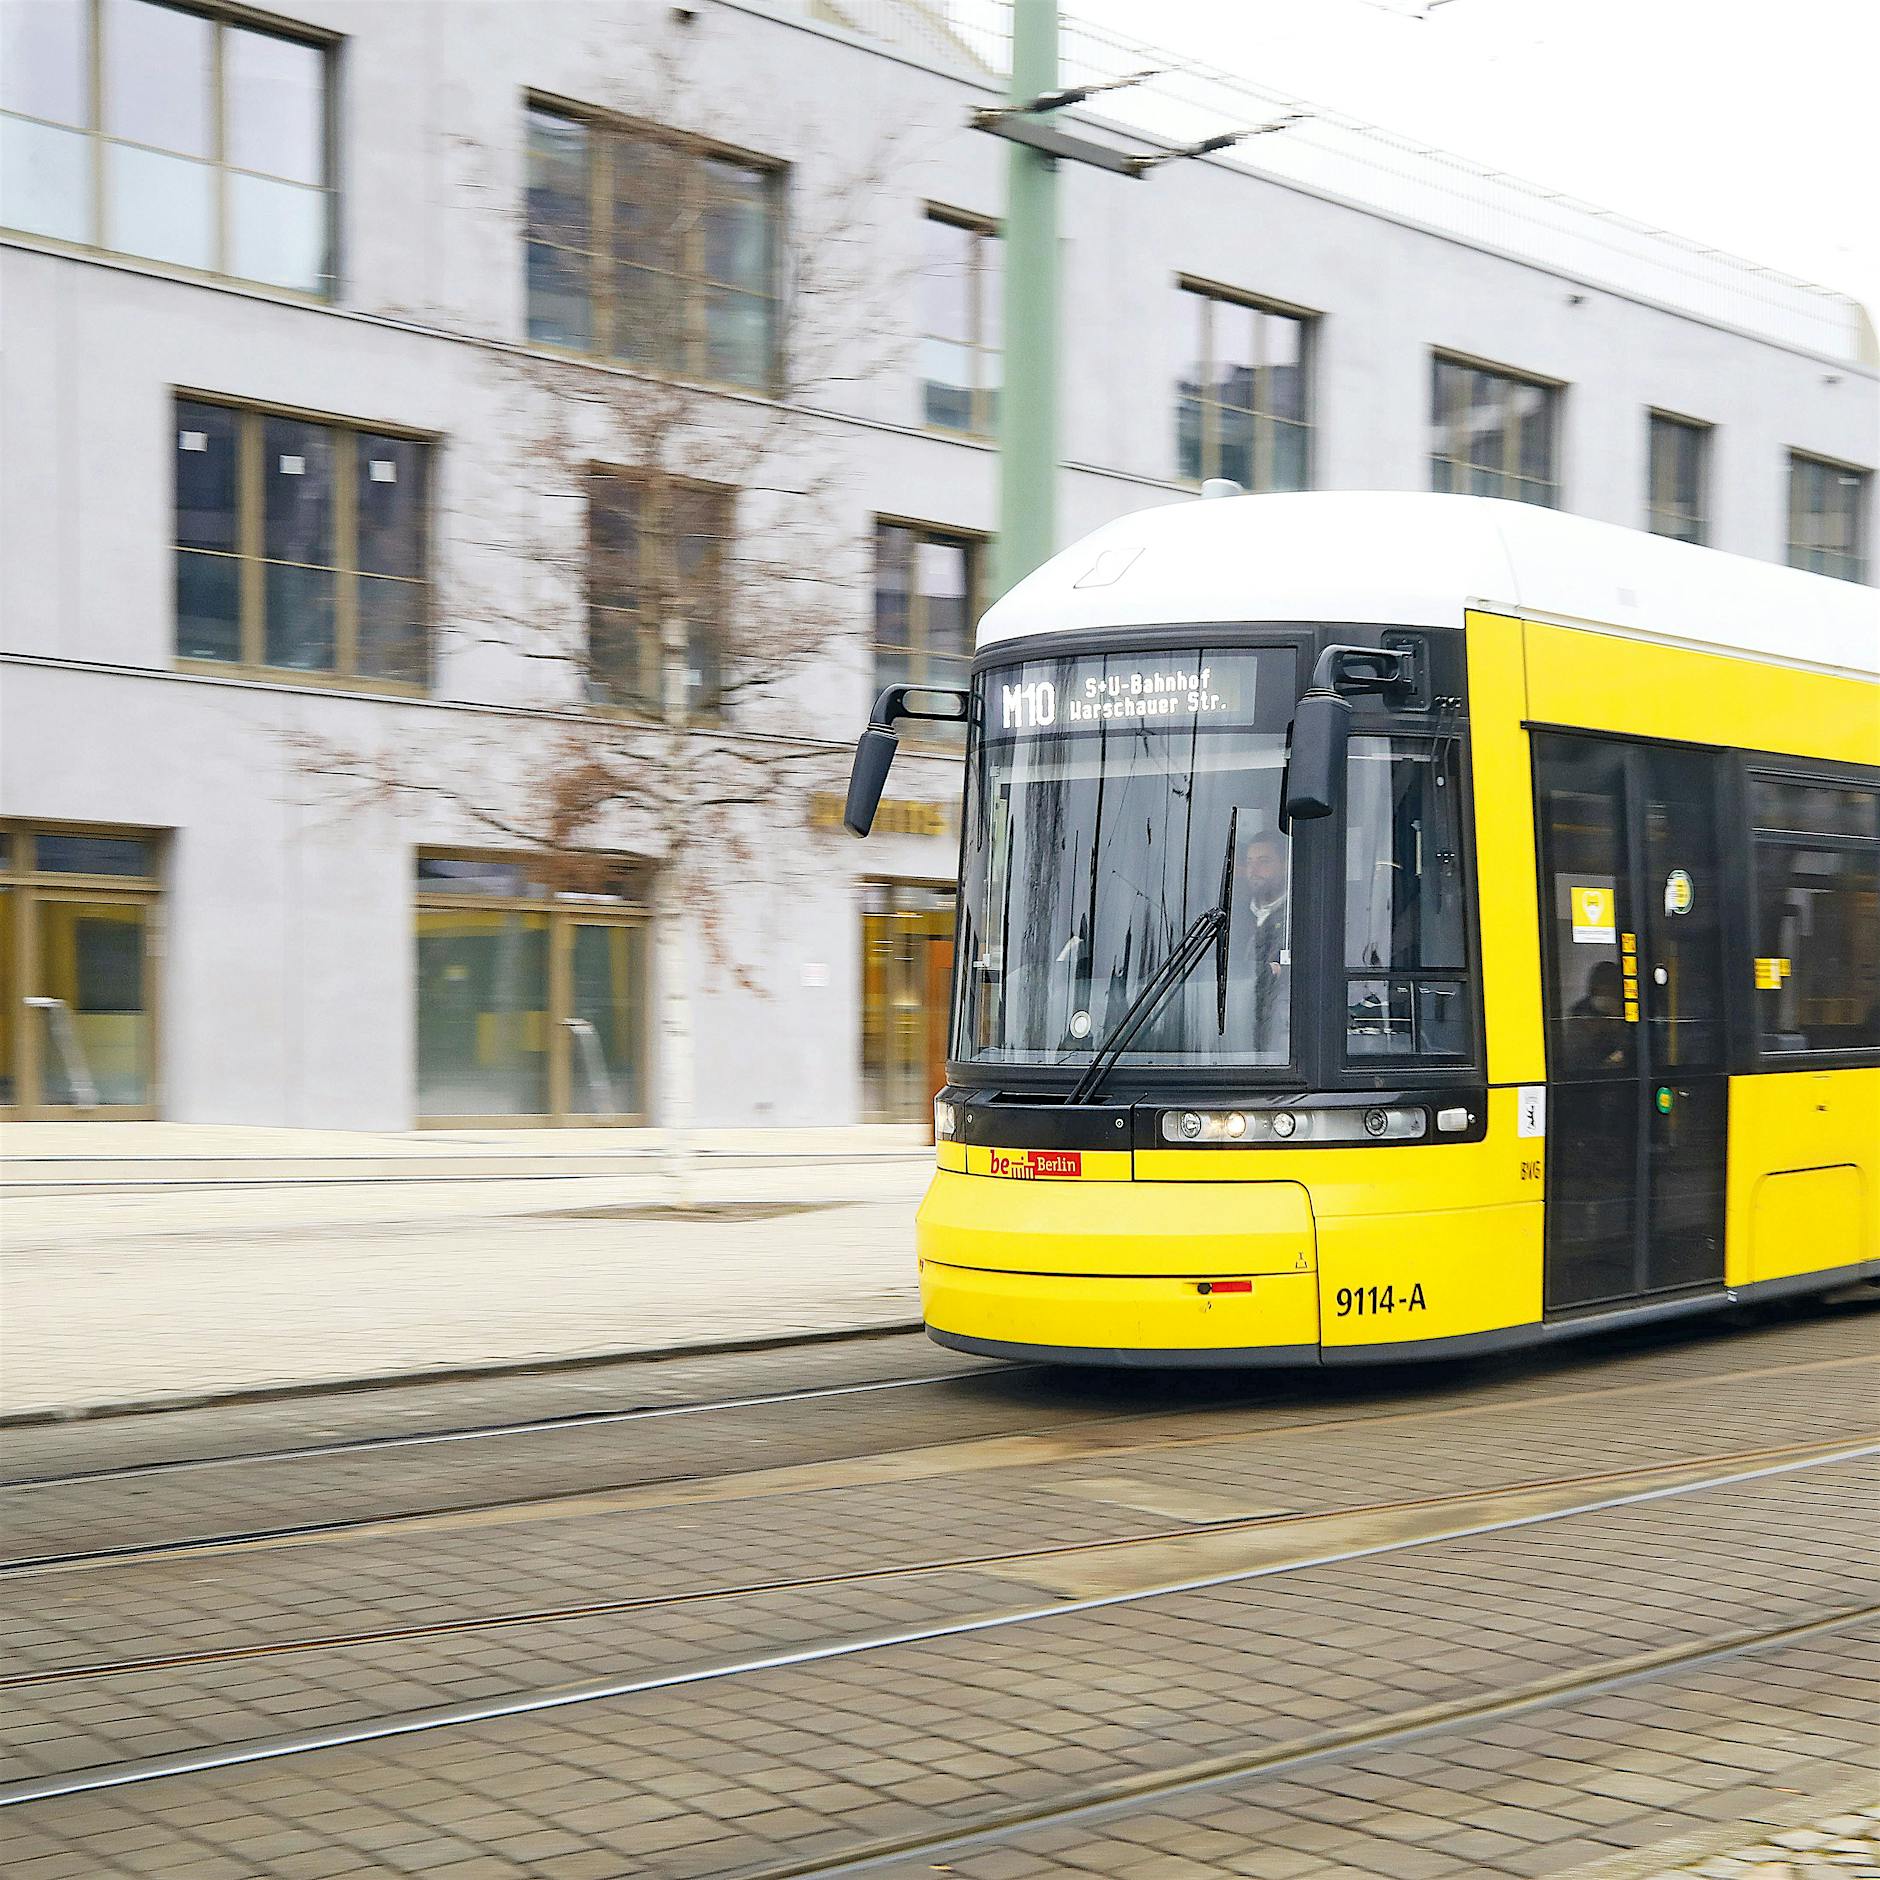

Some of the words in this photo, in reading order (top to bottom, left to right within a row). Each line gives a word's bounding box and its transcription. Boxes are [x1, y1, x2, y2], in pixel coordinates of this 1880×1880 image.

[1085, 667, 1211, 698] S+U-Bahnhof
[1002, 681, 1056, 729] M10
[1069, 697, 1178, 721] Warschauer
[1187, 690, 1227, 712] Str.
[1037, 1156, 1076, 1172] Berlin
[1336, 1283, 1427, 1317] 9114-A
